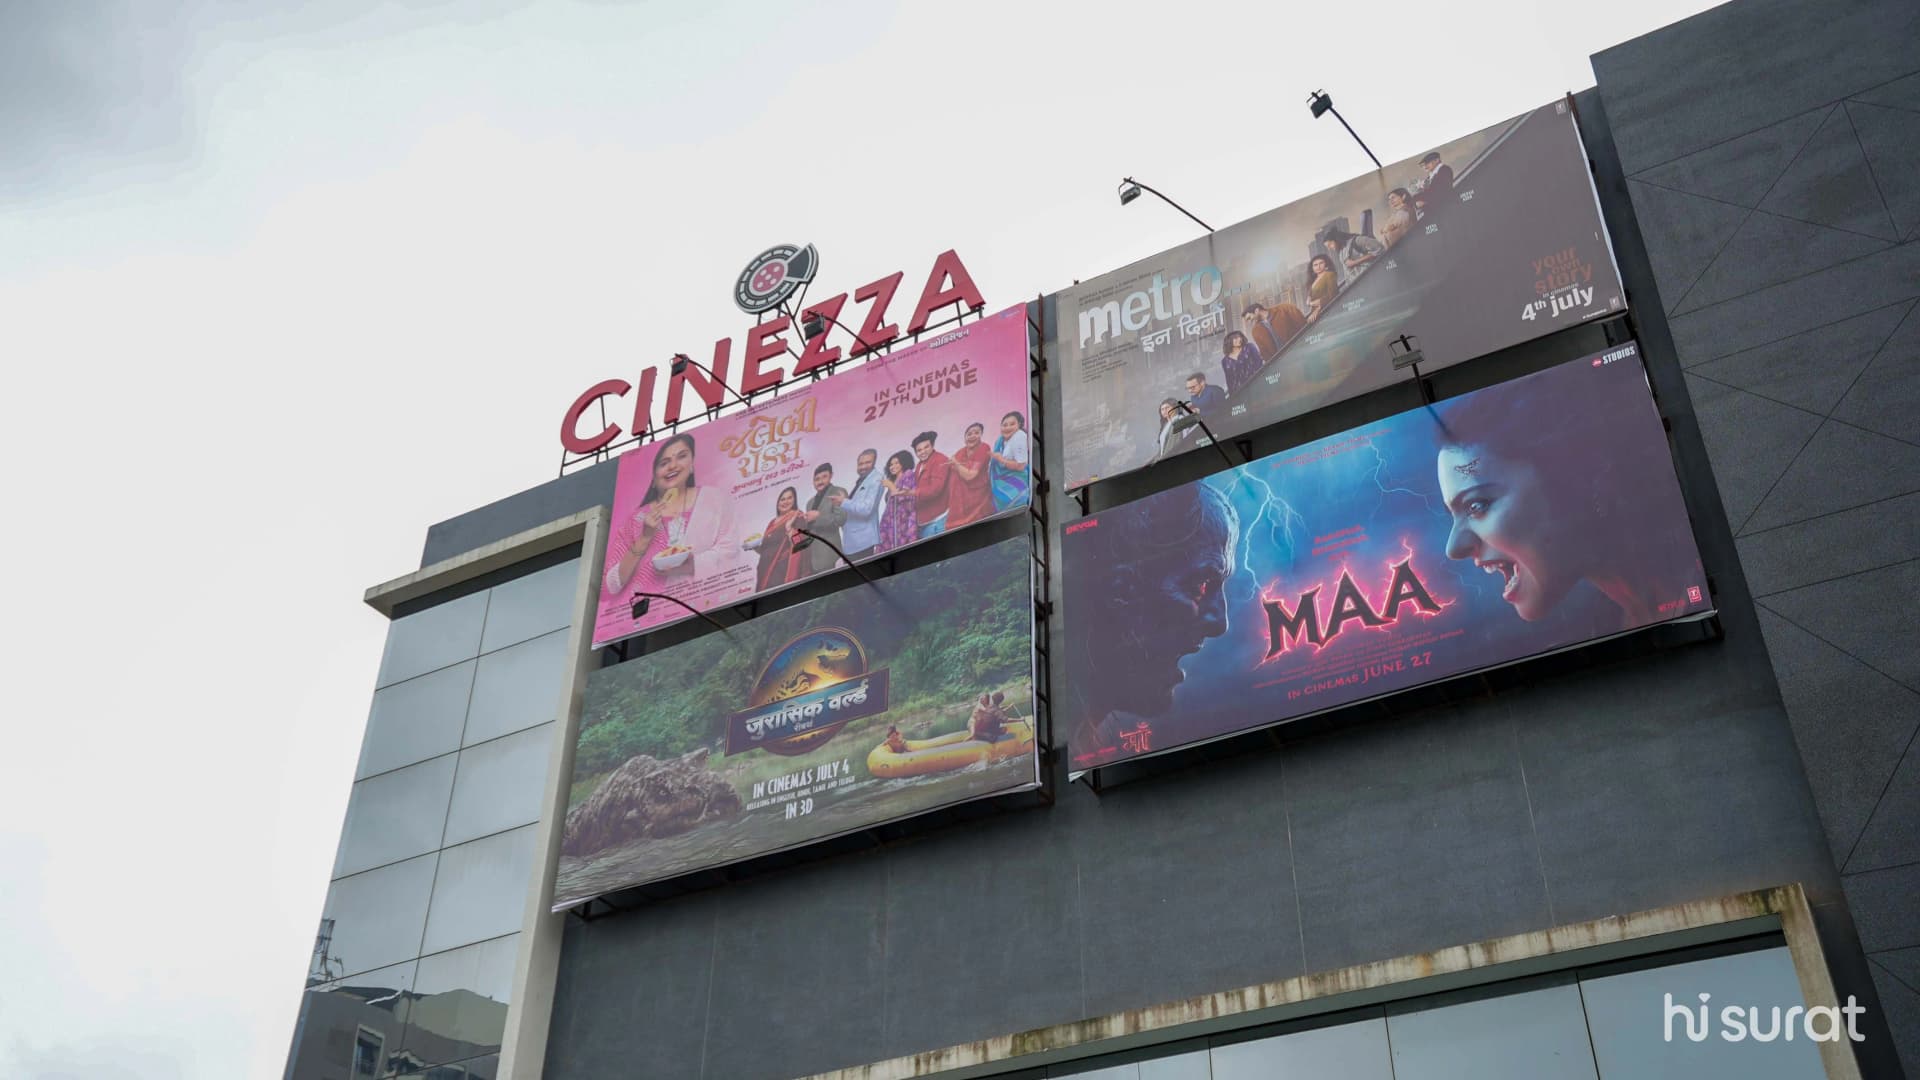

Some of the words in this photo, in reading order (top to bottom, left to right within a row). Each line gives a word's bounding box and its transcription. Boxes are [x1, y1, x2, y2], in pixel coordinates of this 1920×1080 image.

[1521, 299, 1547, 321] 4th
[1549, 286, 1594, 318] july
[560, 249, 986, 455] CINEZZA
[1140, 327, 1172, 352] इन
[1602, 346, 1636, 365] STUDIOS
[874, 387, 890, 402] IN
[895, 359, 970, 394] CINEMAS
[911, 367, 978, 405] JUNE
[1260, 555, 1446, 664] MAA
[1287, 688, 1302, 700] IN
[1303, 676, 1359, 696] CINEMAS
[1360, 663, 1406, 684] JUNE
[1410, 652, 1432, 668] 27
[745, 698, 825, 740] जुरासिक
[828, 678, 869, 711] वर्ल्ड
[752, 783, 764, 799] IN
[767, 769, 813, 795] CINEMAS
[815, 761, 841, 782] JULY
[841, 758, 849, 774] 4
[785, 801, 797, 820] IN
[800, 798, 813, 816] 3D
